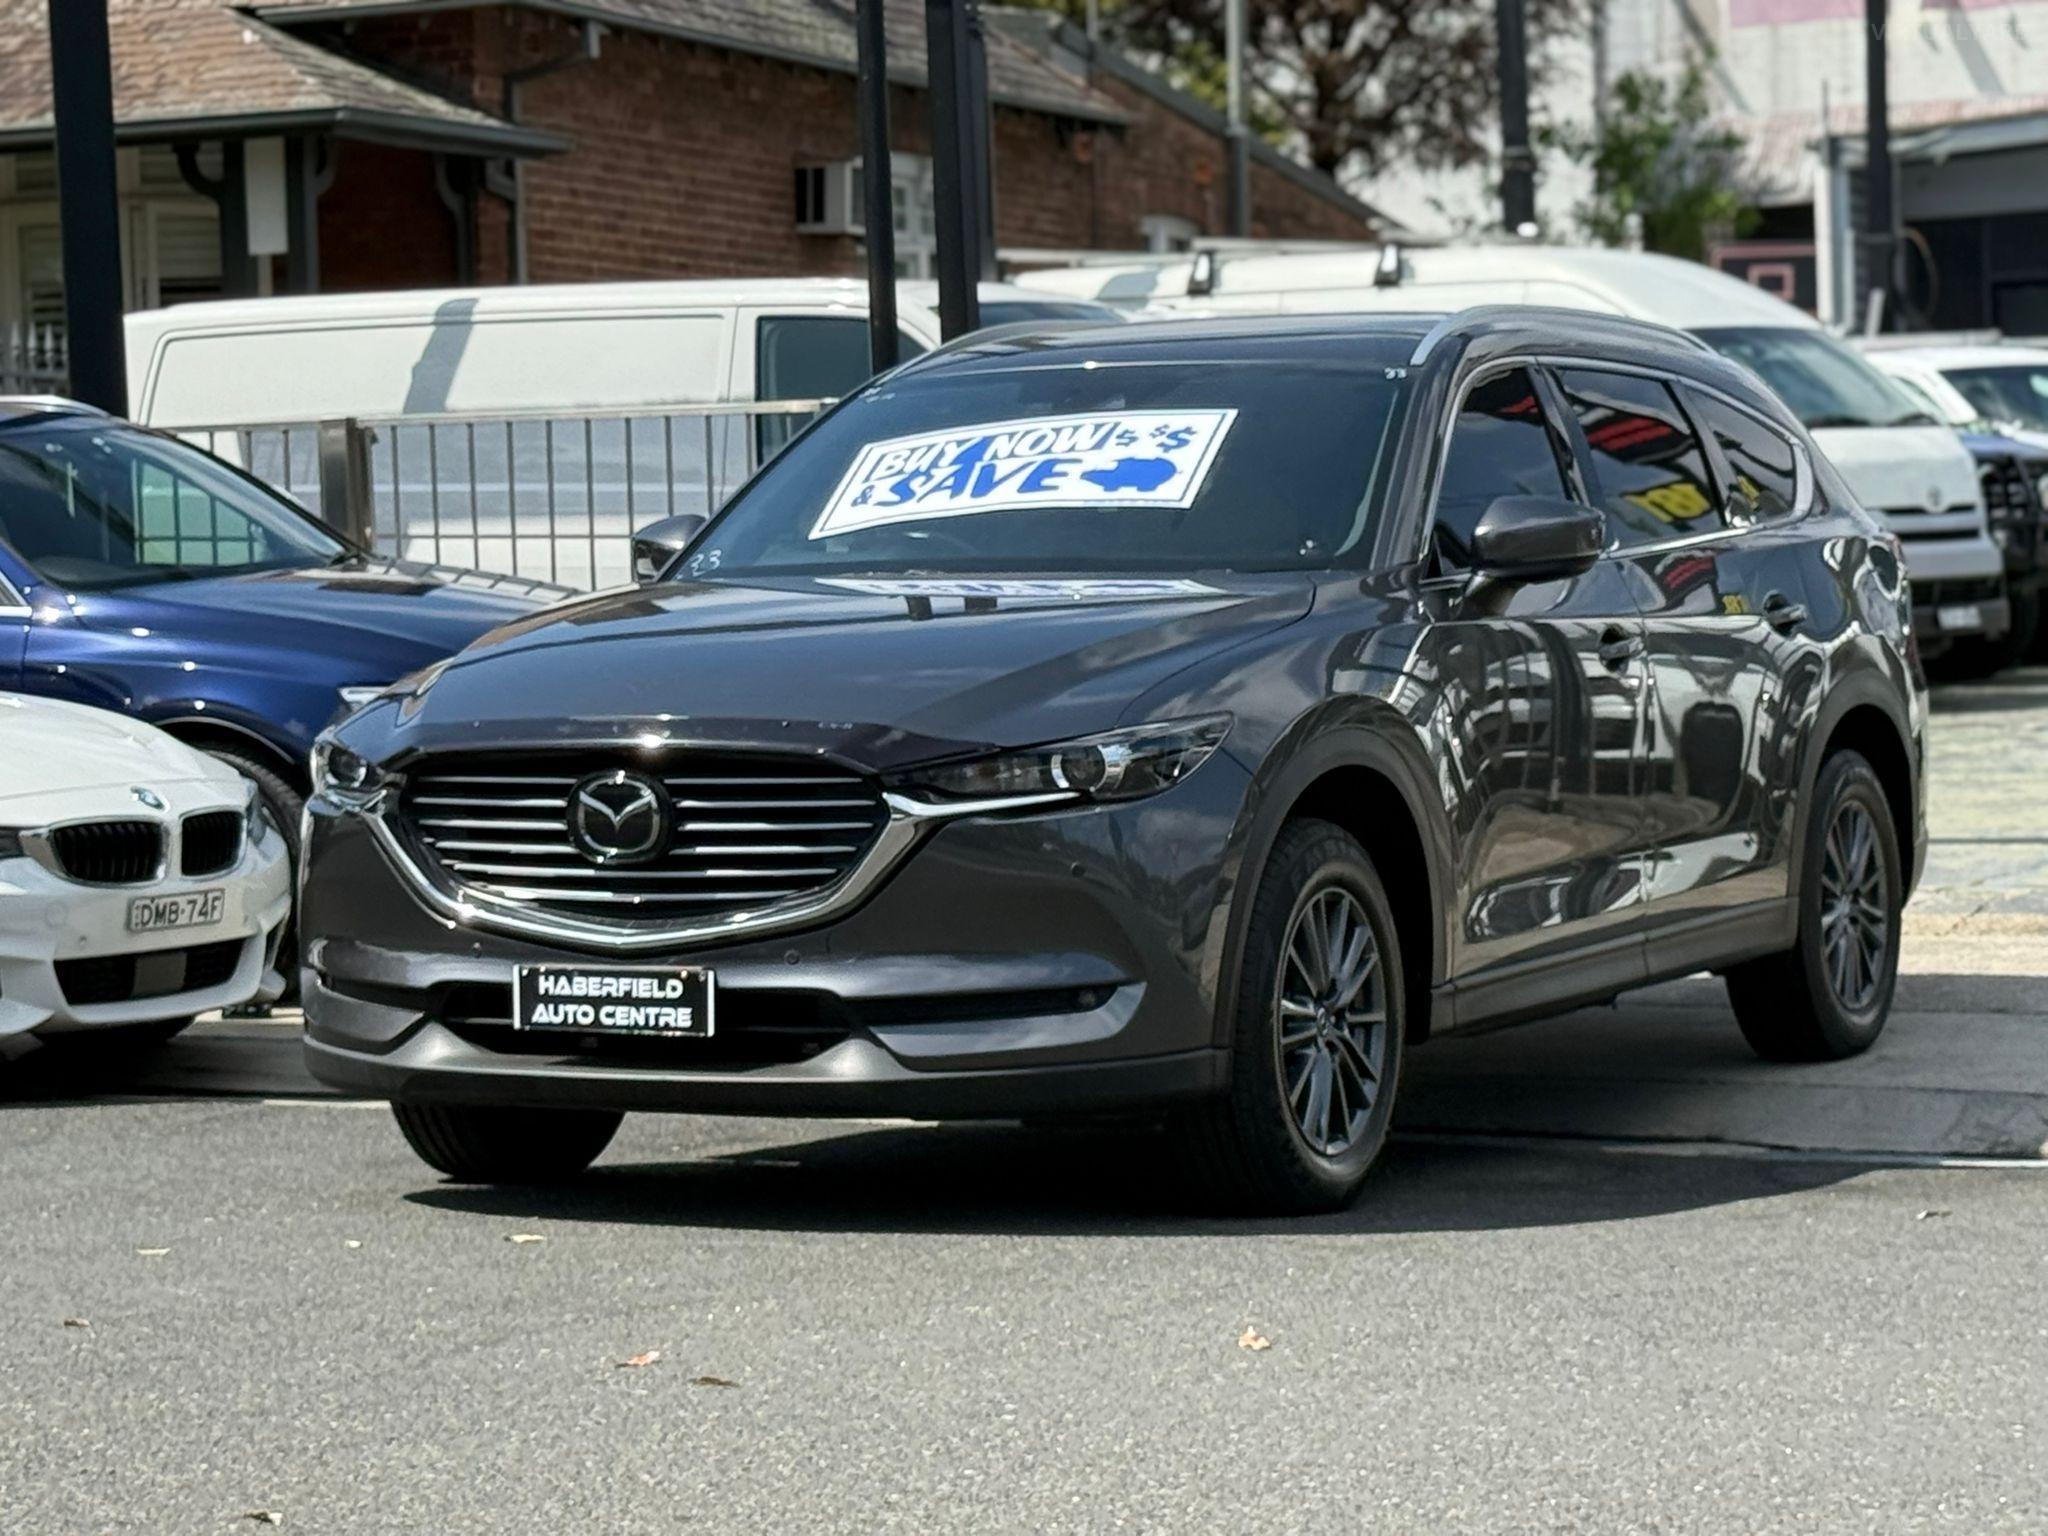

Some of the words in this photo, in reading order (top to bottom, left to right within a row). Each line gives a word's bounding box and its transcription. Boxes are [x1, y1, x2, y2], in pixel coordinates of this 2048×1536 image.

[864, 436, 986, 483] BUY
[872, 457, 1084, 507] SAVE
[538, 974, 684, 999] HABERFIELD
[531, 1003, 596, 1025] AUTO
[599, 1005, 693, 1028] CENTRE
